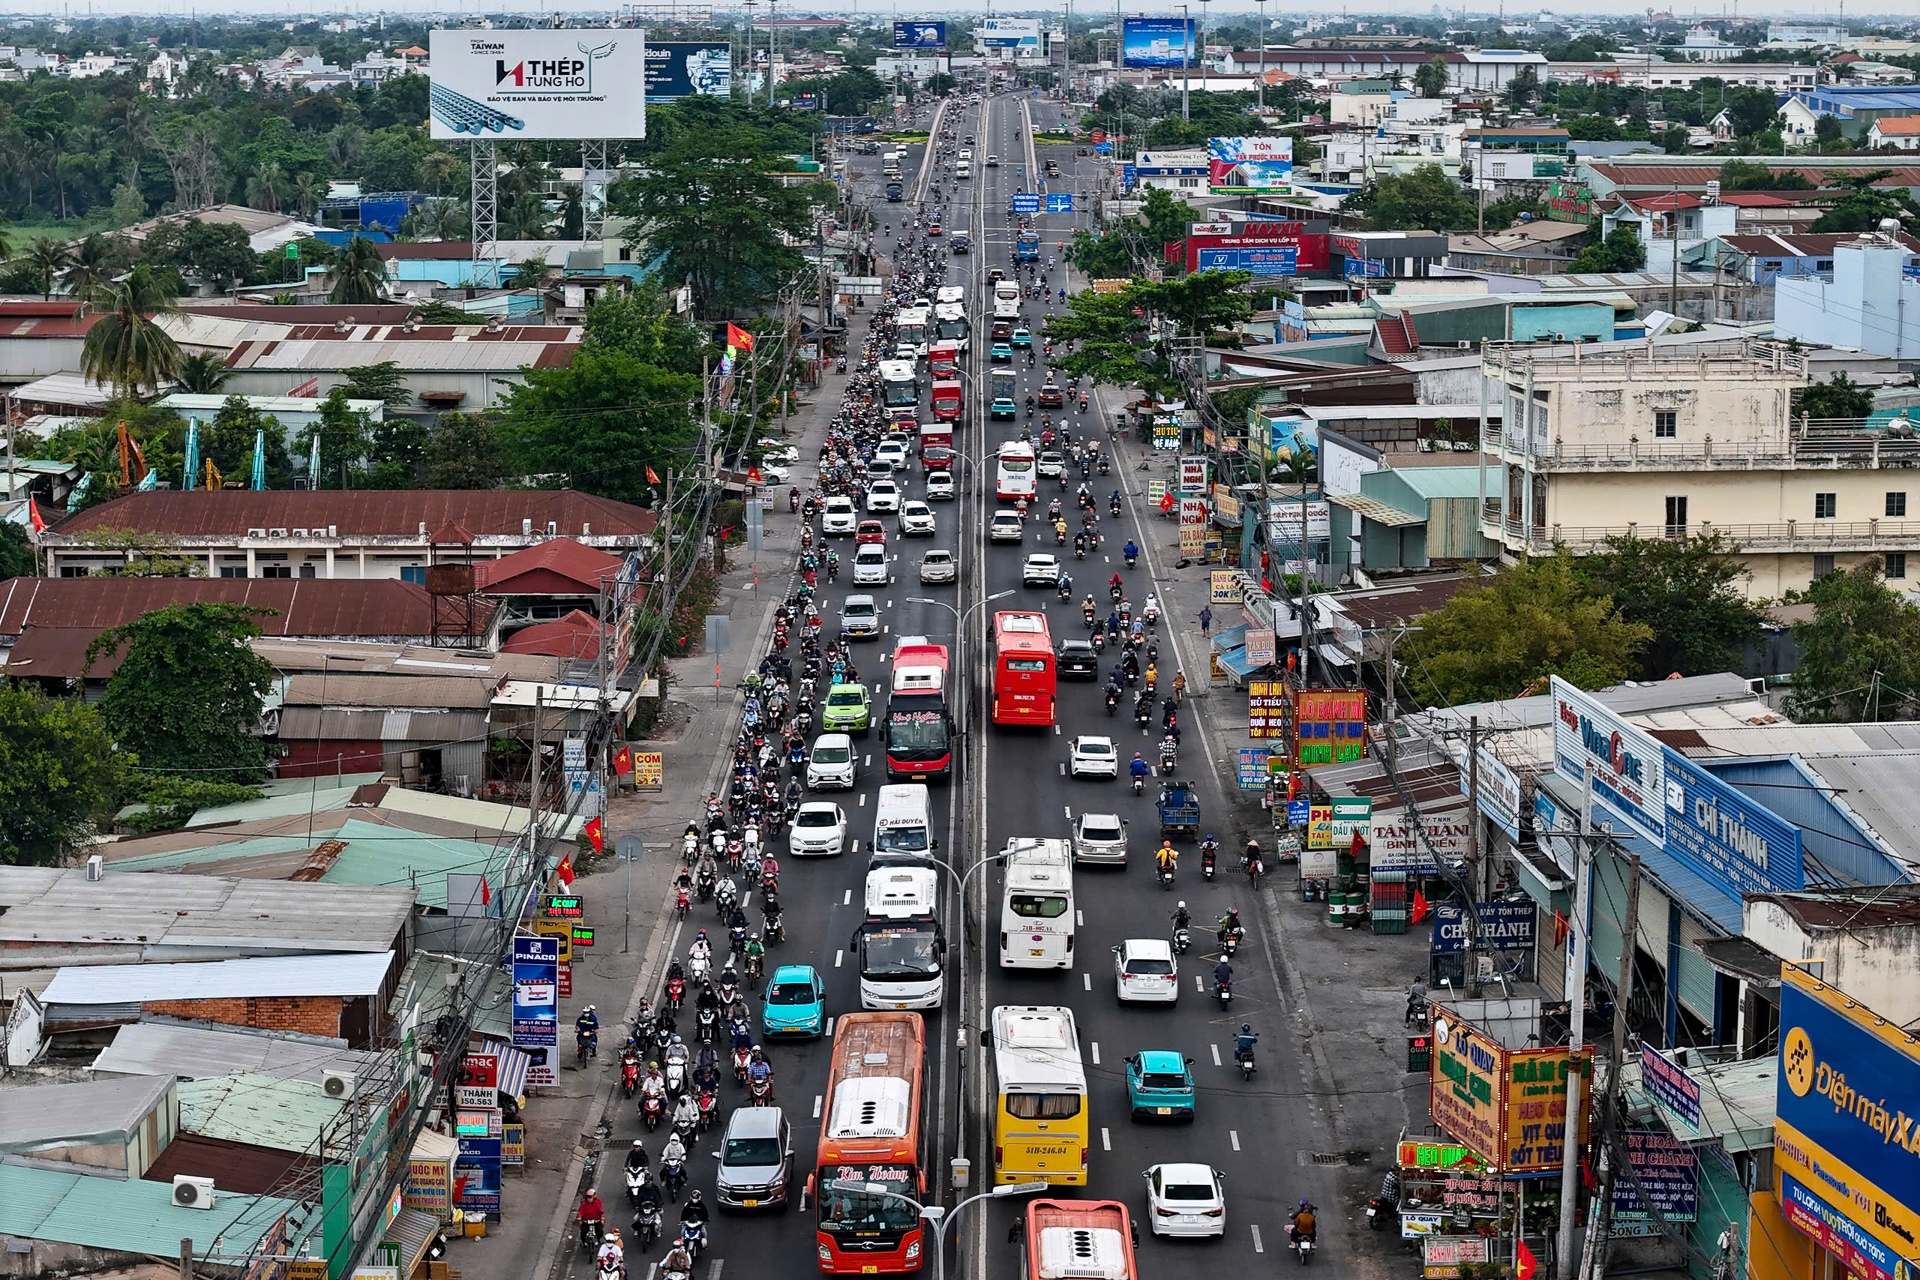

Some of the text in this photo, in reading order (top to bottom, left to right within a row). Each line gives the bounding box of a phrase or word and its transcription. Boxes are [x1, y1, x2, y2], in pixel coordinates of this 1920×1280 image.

[528, 56, 584, 76] THÉP
[526, 76, 585, 87] TUNG HO
[1253, 142, 1272, 150] TÔN
[1242, 222, 1303, 235] MAXXIS
[1308, 508, 1328, 517] QUỐC
[1250, 696, 1282, 706] HỦ TIẾU
[1300, 695, 1314, 719] LÒ
[1318, 695, 1348, 720] BÁNH
[637, 754, 661, 763] CƠM
[1333, 823, 1348, 836] DẦU
[1373, 824, 1409, 838] TÂN
[1696, 796, 1768, 870] CHÍ THÀNH
[1498, 906, 1513, 916] TÔN
[1514, 905, 1533, 915] THÉP
[1470, 1042, 1495, 1075] QUAY
[1513, 1058, 1554, 1083] NĂM
[463, 1088, 493, 1098] THÀNH
[1816, 1061, 1898, 1145] Điện máy
[1417, 1147, 1438, 1166] HEO
[1774, 1134, 1810, 1170] TOSHIBA
[837, 1165, 909, 1183] Kim Hoàng
